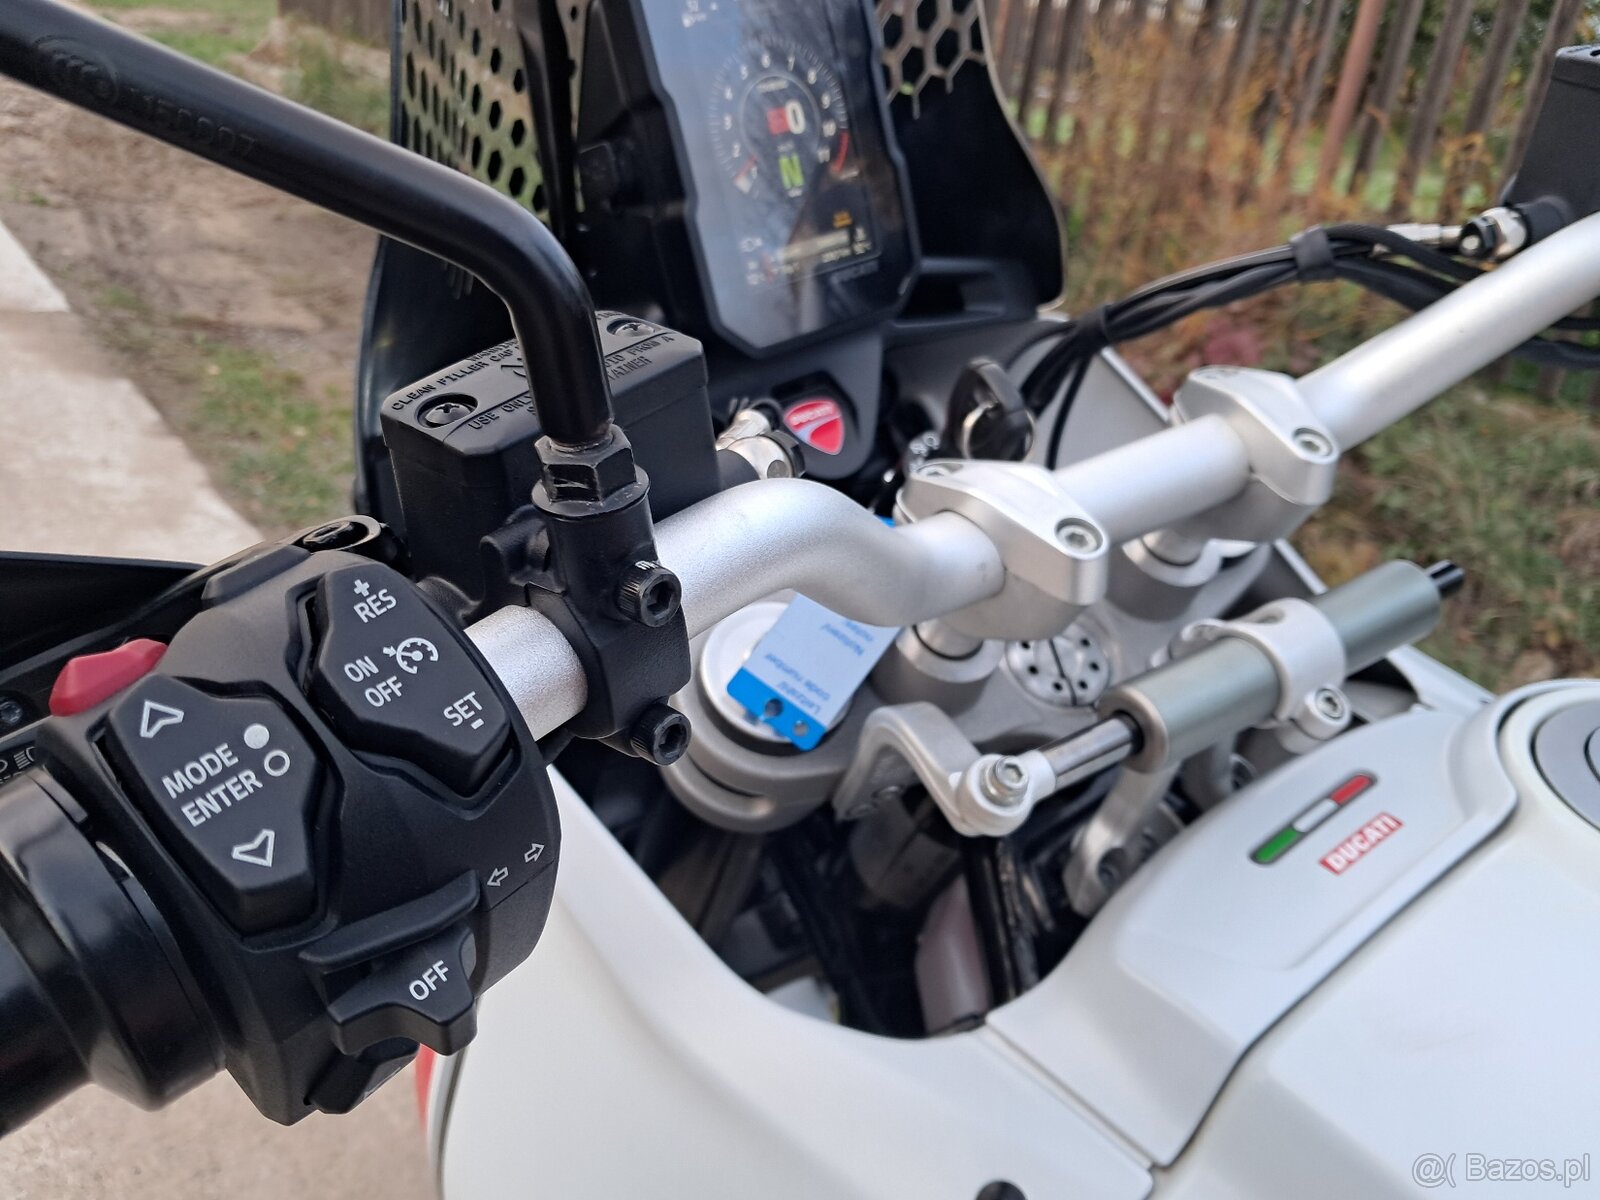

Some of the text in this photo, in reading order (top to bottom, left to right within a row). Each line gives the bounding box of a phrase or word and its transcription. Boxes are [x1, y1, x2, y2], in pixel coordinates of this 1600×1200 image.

[786, 101, 805, 134] 0
[779, 153, 804, 189] N
[392, 384, 436, 411] CLEAN
[437, 359, 489, 386] FILLER
[468, 408, 499, 430] USE
[353, 588, 397, 623] RES
[344, 656, 379, 682] ON
[764, 652, 802, 684] number
[364, 676, 403, 708] OFF
[443, 692, 483, 727] SET
[162, 742, 239, 800] MODE
[181, 770, 263, 828] ENTER
[1325, 813, 1400, 874] DUCATI
[408, 960, 450, 1001] OFF
